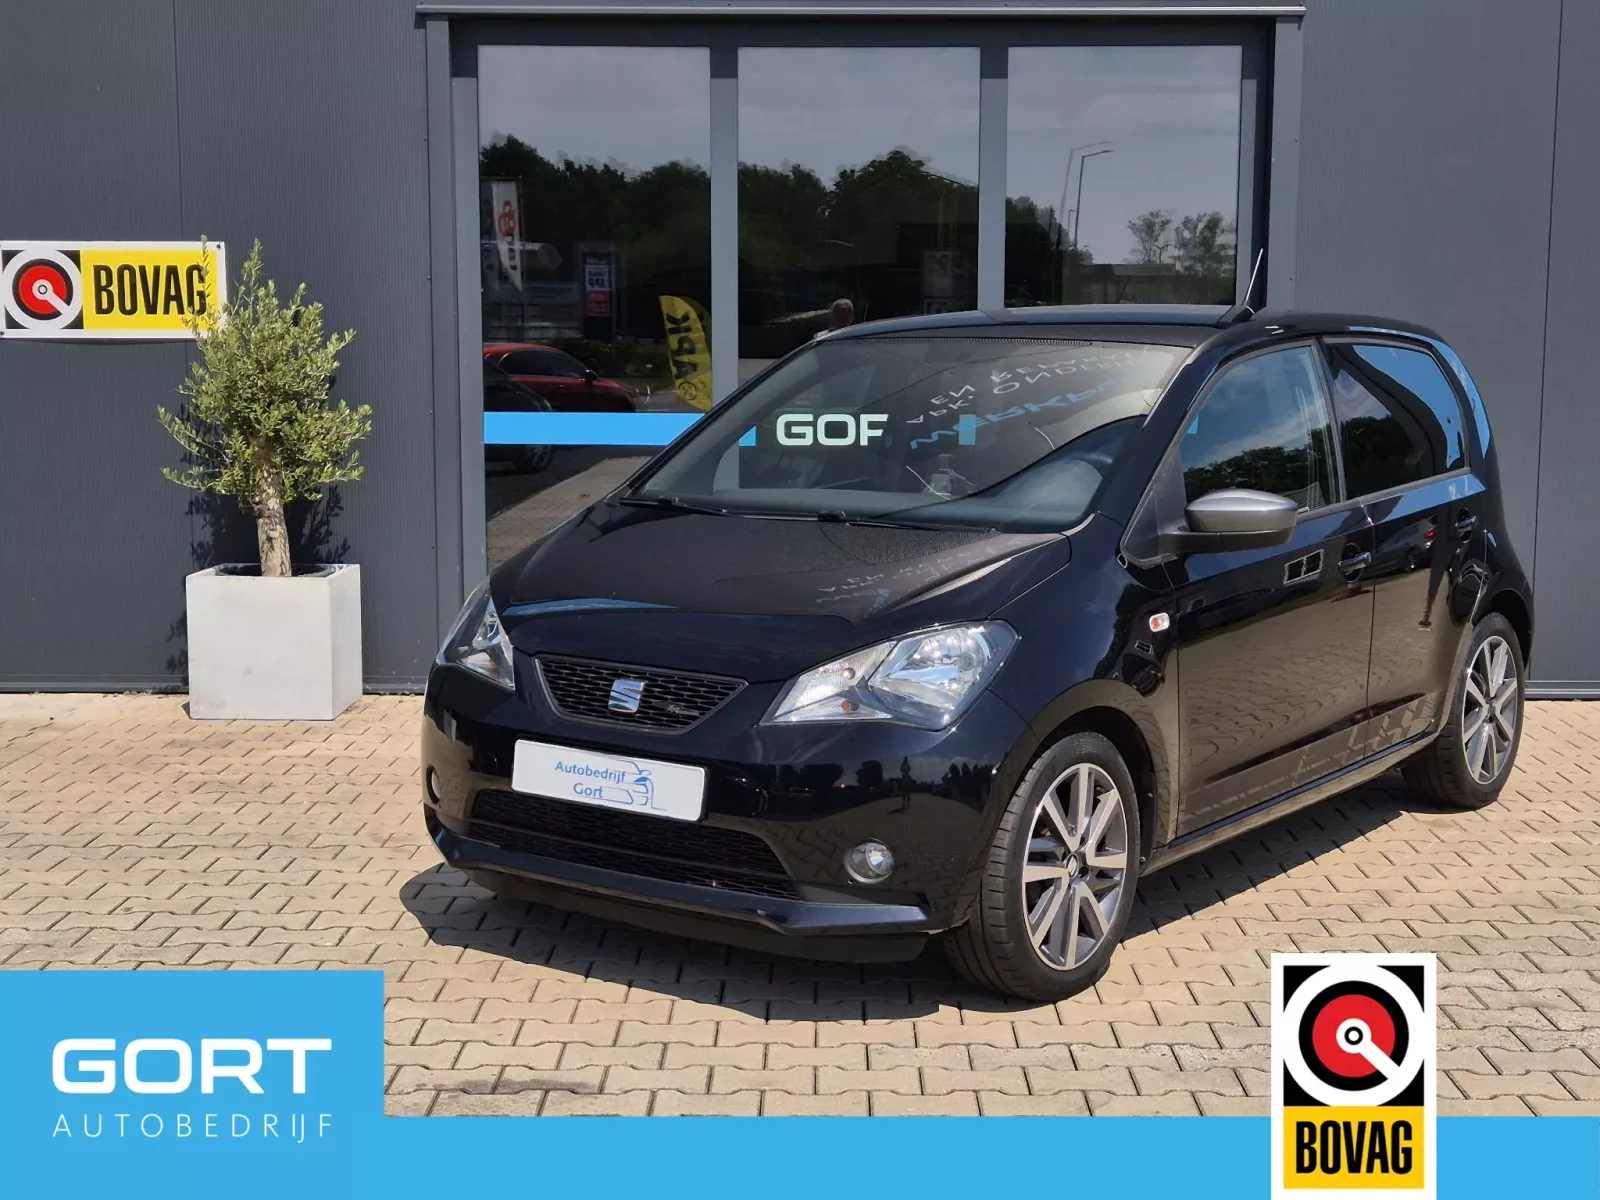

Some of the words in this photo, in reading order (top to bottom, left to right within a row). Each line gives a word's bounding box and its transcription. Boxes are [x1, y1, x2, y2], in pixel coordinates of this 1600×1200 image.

[93, 264, 207, 316] BOVAG
[554, 761, 627, 783] Autobedrijf
[573, 782, 604, 799] Gort
